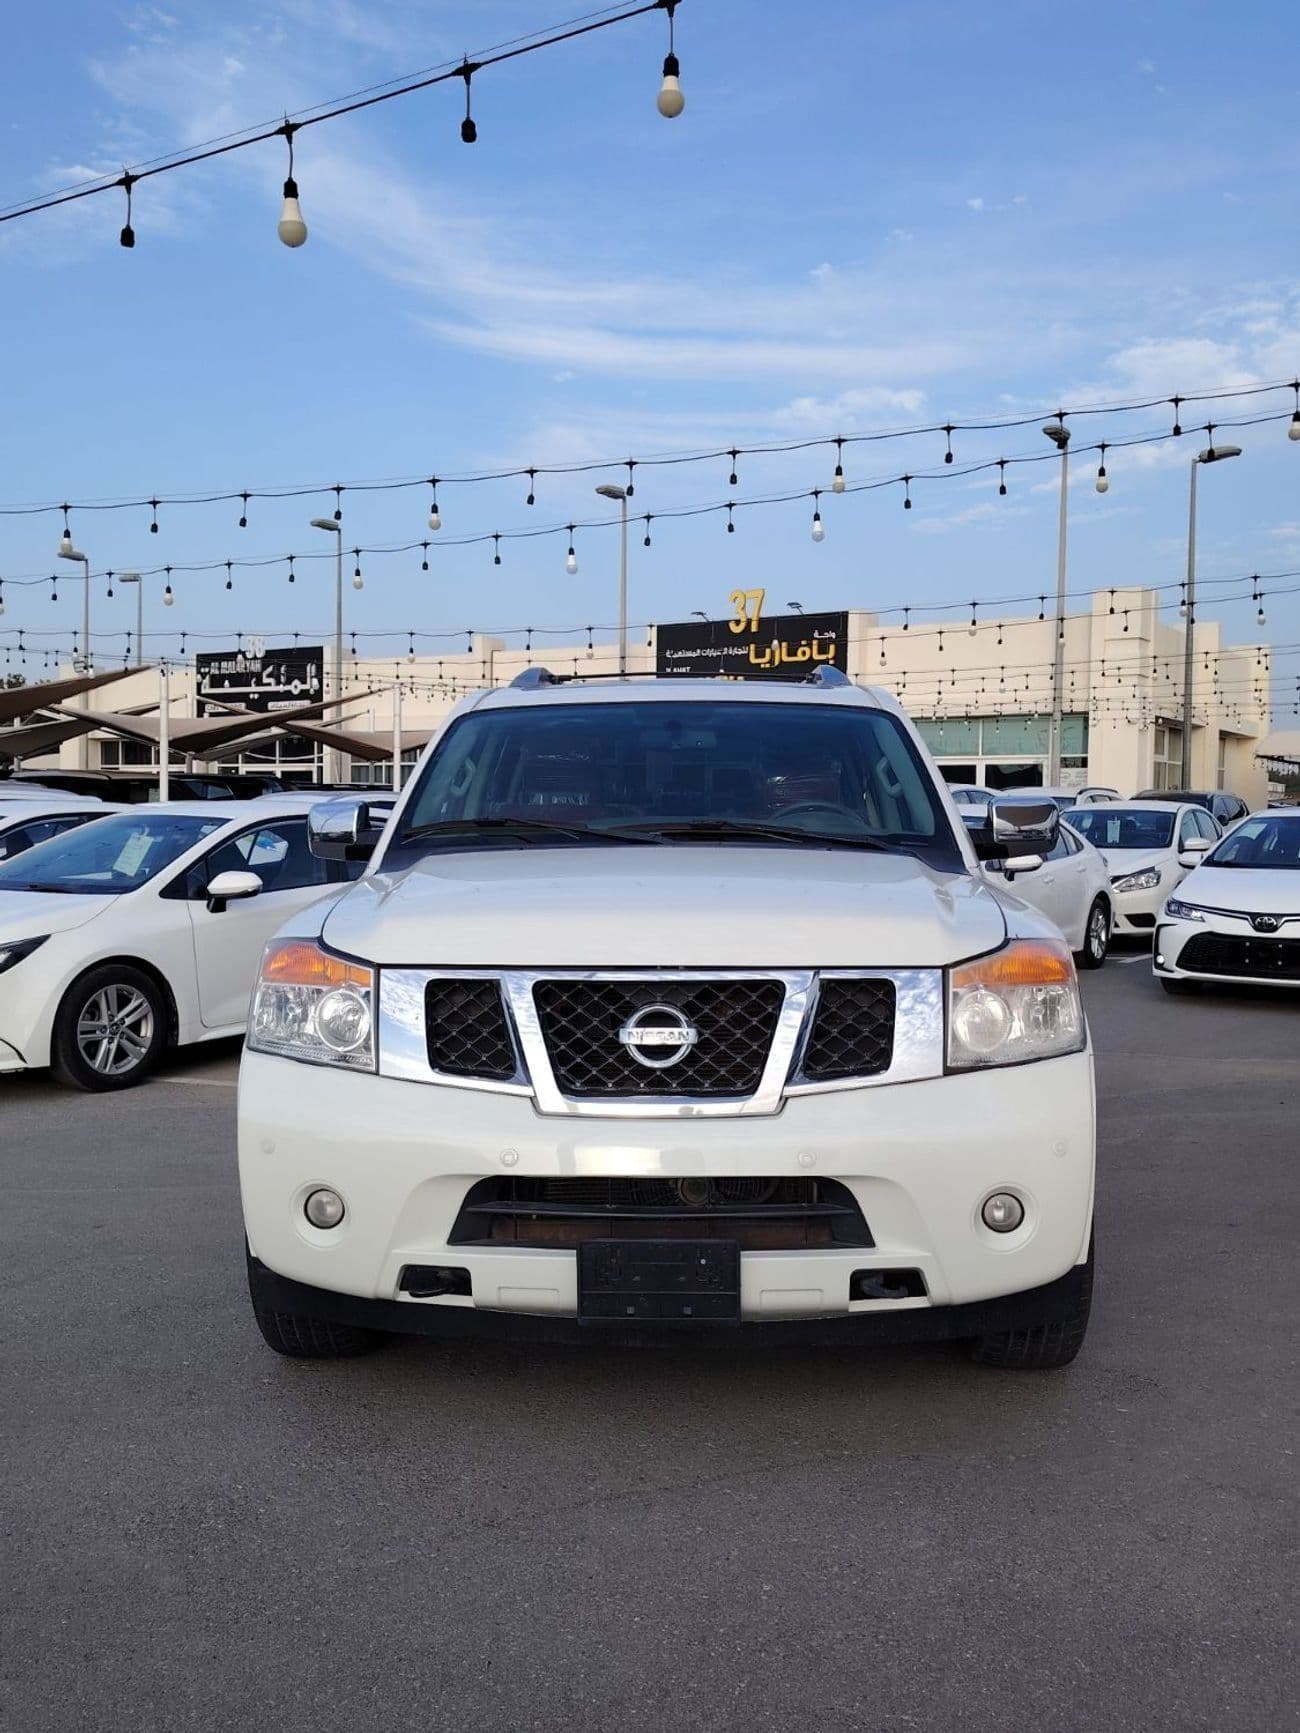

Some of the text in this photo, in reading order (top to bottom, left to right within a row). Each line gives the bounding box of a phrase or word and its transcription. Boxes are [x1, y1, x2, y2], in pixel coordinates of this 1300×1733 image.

[728, 588, 765, 634] 37
[749, 639, 836, 668] بافاريا
[627, 1030, 689, 1042] NISSAN
